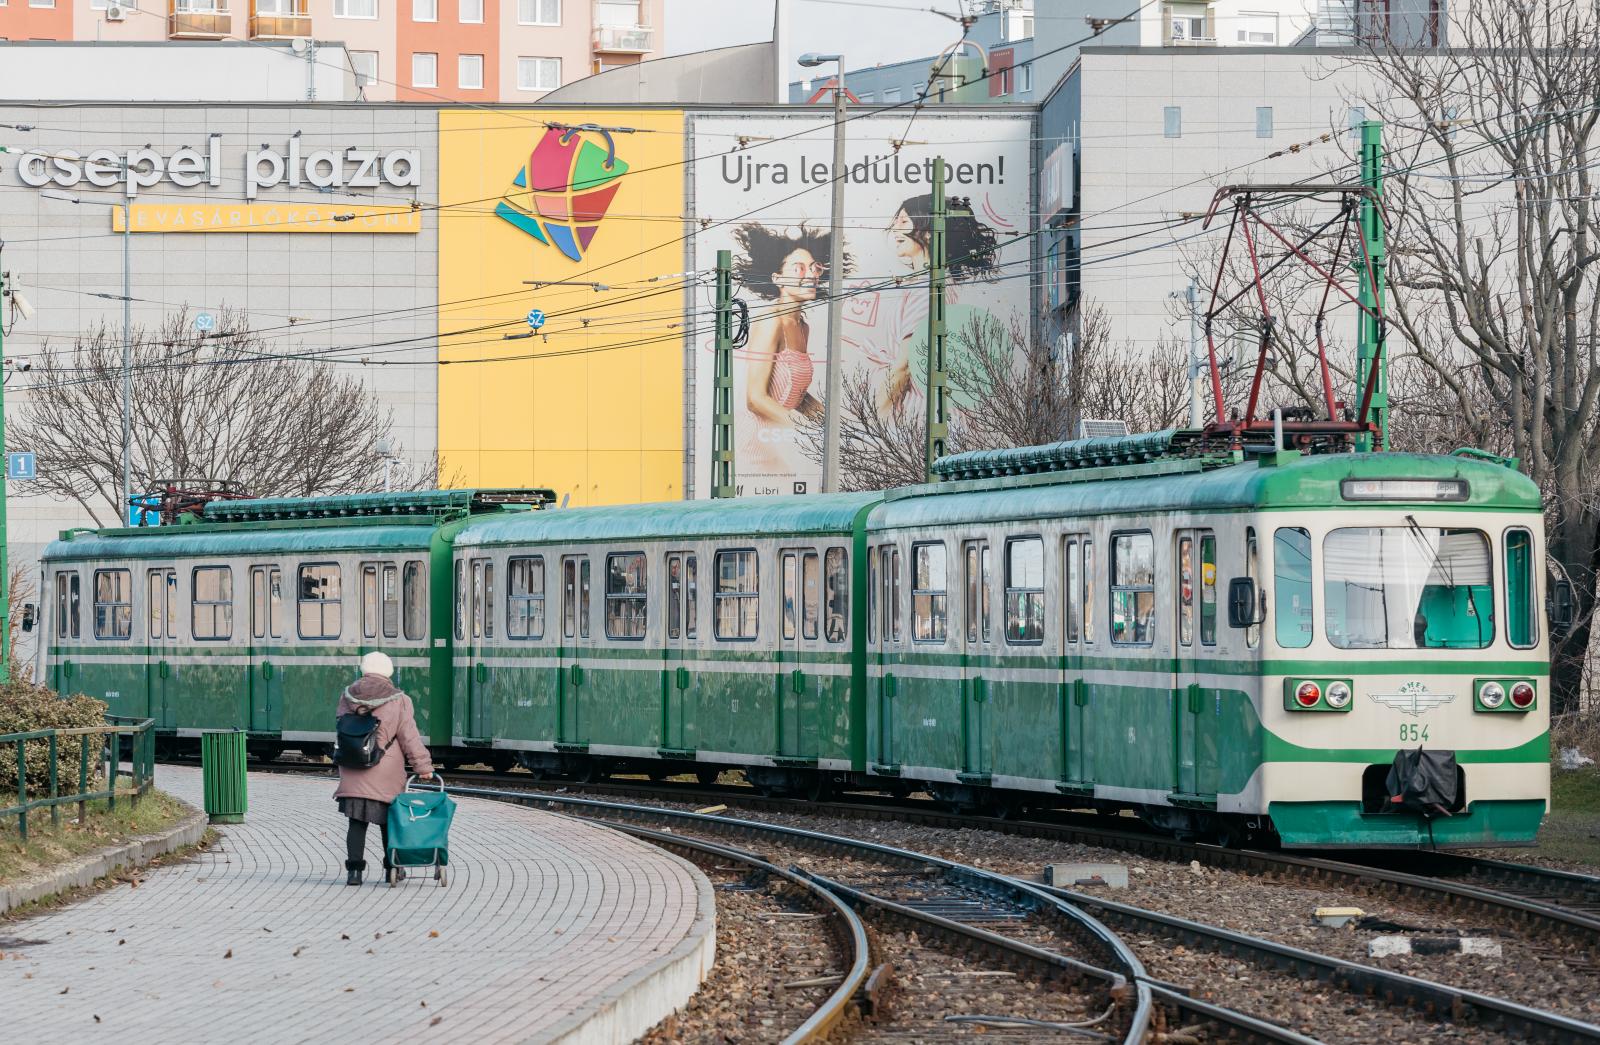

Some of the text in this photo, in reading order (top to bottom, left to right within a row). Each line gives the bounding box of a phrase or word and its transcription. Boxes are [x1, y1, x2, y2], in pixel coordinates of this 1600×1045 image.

[18, 137, 421, 199] csepel plaza
[721, 146, 788, 192] Újra
[197, 315, 212, 329] SZ
[527, 311, 543, 326] SZ
[17, 456, 27, 473] 1
[754, 486, 779, 495] Libri
[1399, 723, 1429, 742] 854
